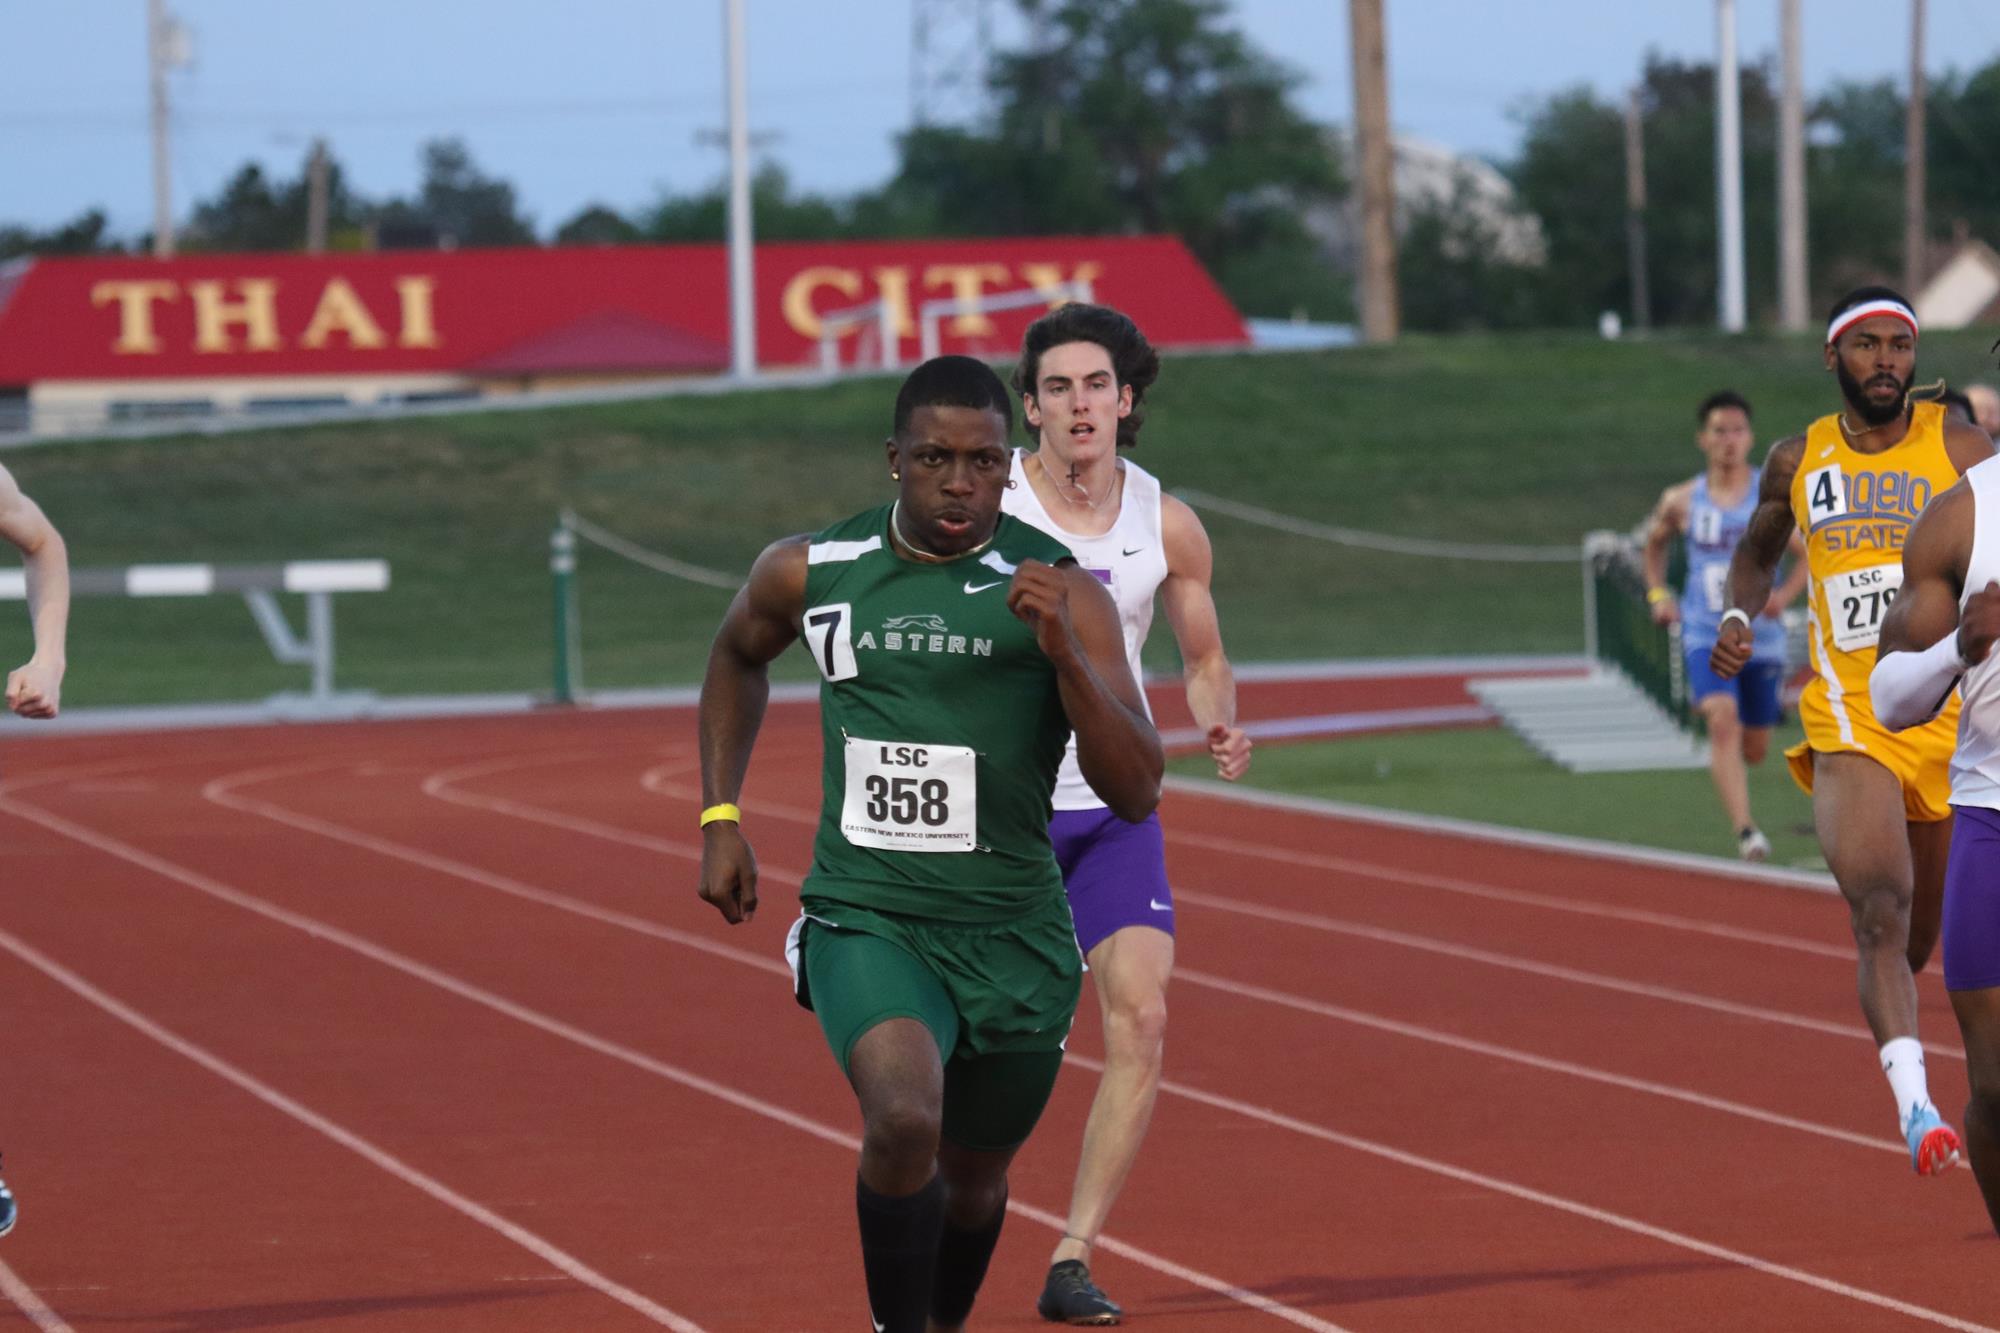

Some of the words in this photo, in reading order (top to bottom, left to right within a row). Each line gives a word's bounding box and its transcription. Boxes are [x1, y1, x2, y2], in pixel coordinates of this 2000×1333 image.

[91, 275, 441, 355] THAI
[1812, 470, 1837, 512] 4
[1842, 471, 1932, 517] ngelo
[1824, 524, 1907, 551] STATE
[1849, 569, 1883, 588] LSC
[809, 610, 842, 676] 7
[857, 631, 992, 656] ASTERN
[880, 746, 929, 768] LSC
[865, 774, 949, 827] 358
[845, 824, 877, 834] EASTERN
[878, 829, 893, 837] NEW
[894, 831, 923, 839] MEXICO
